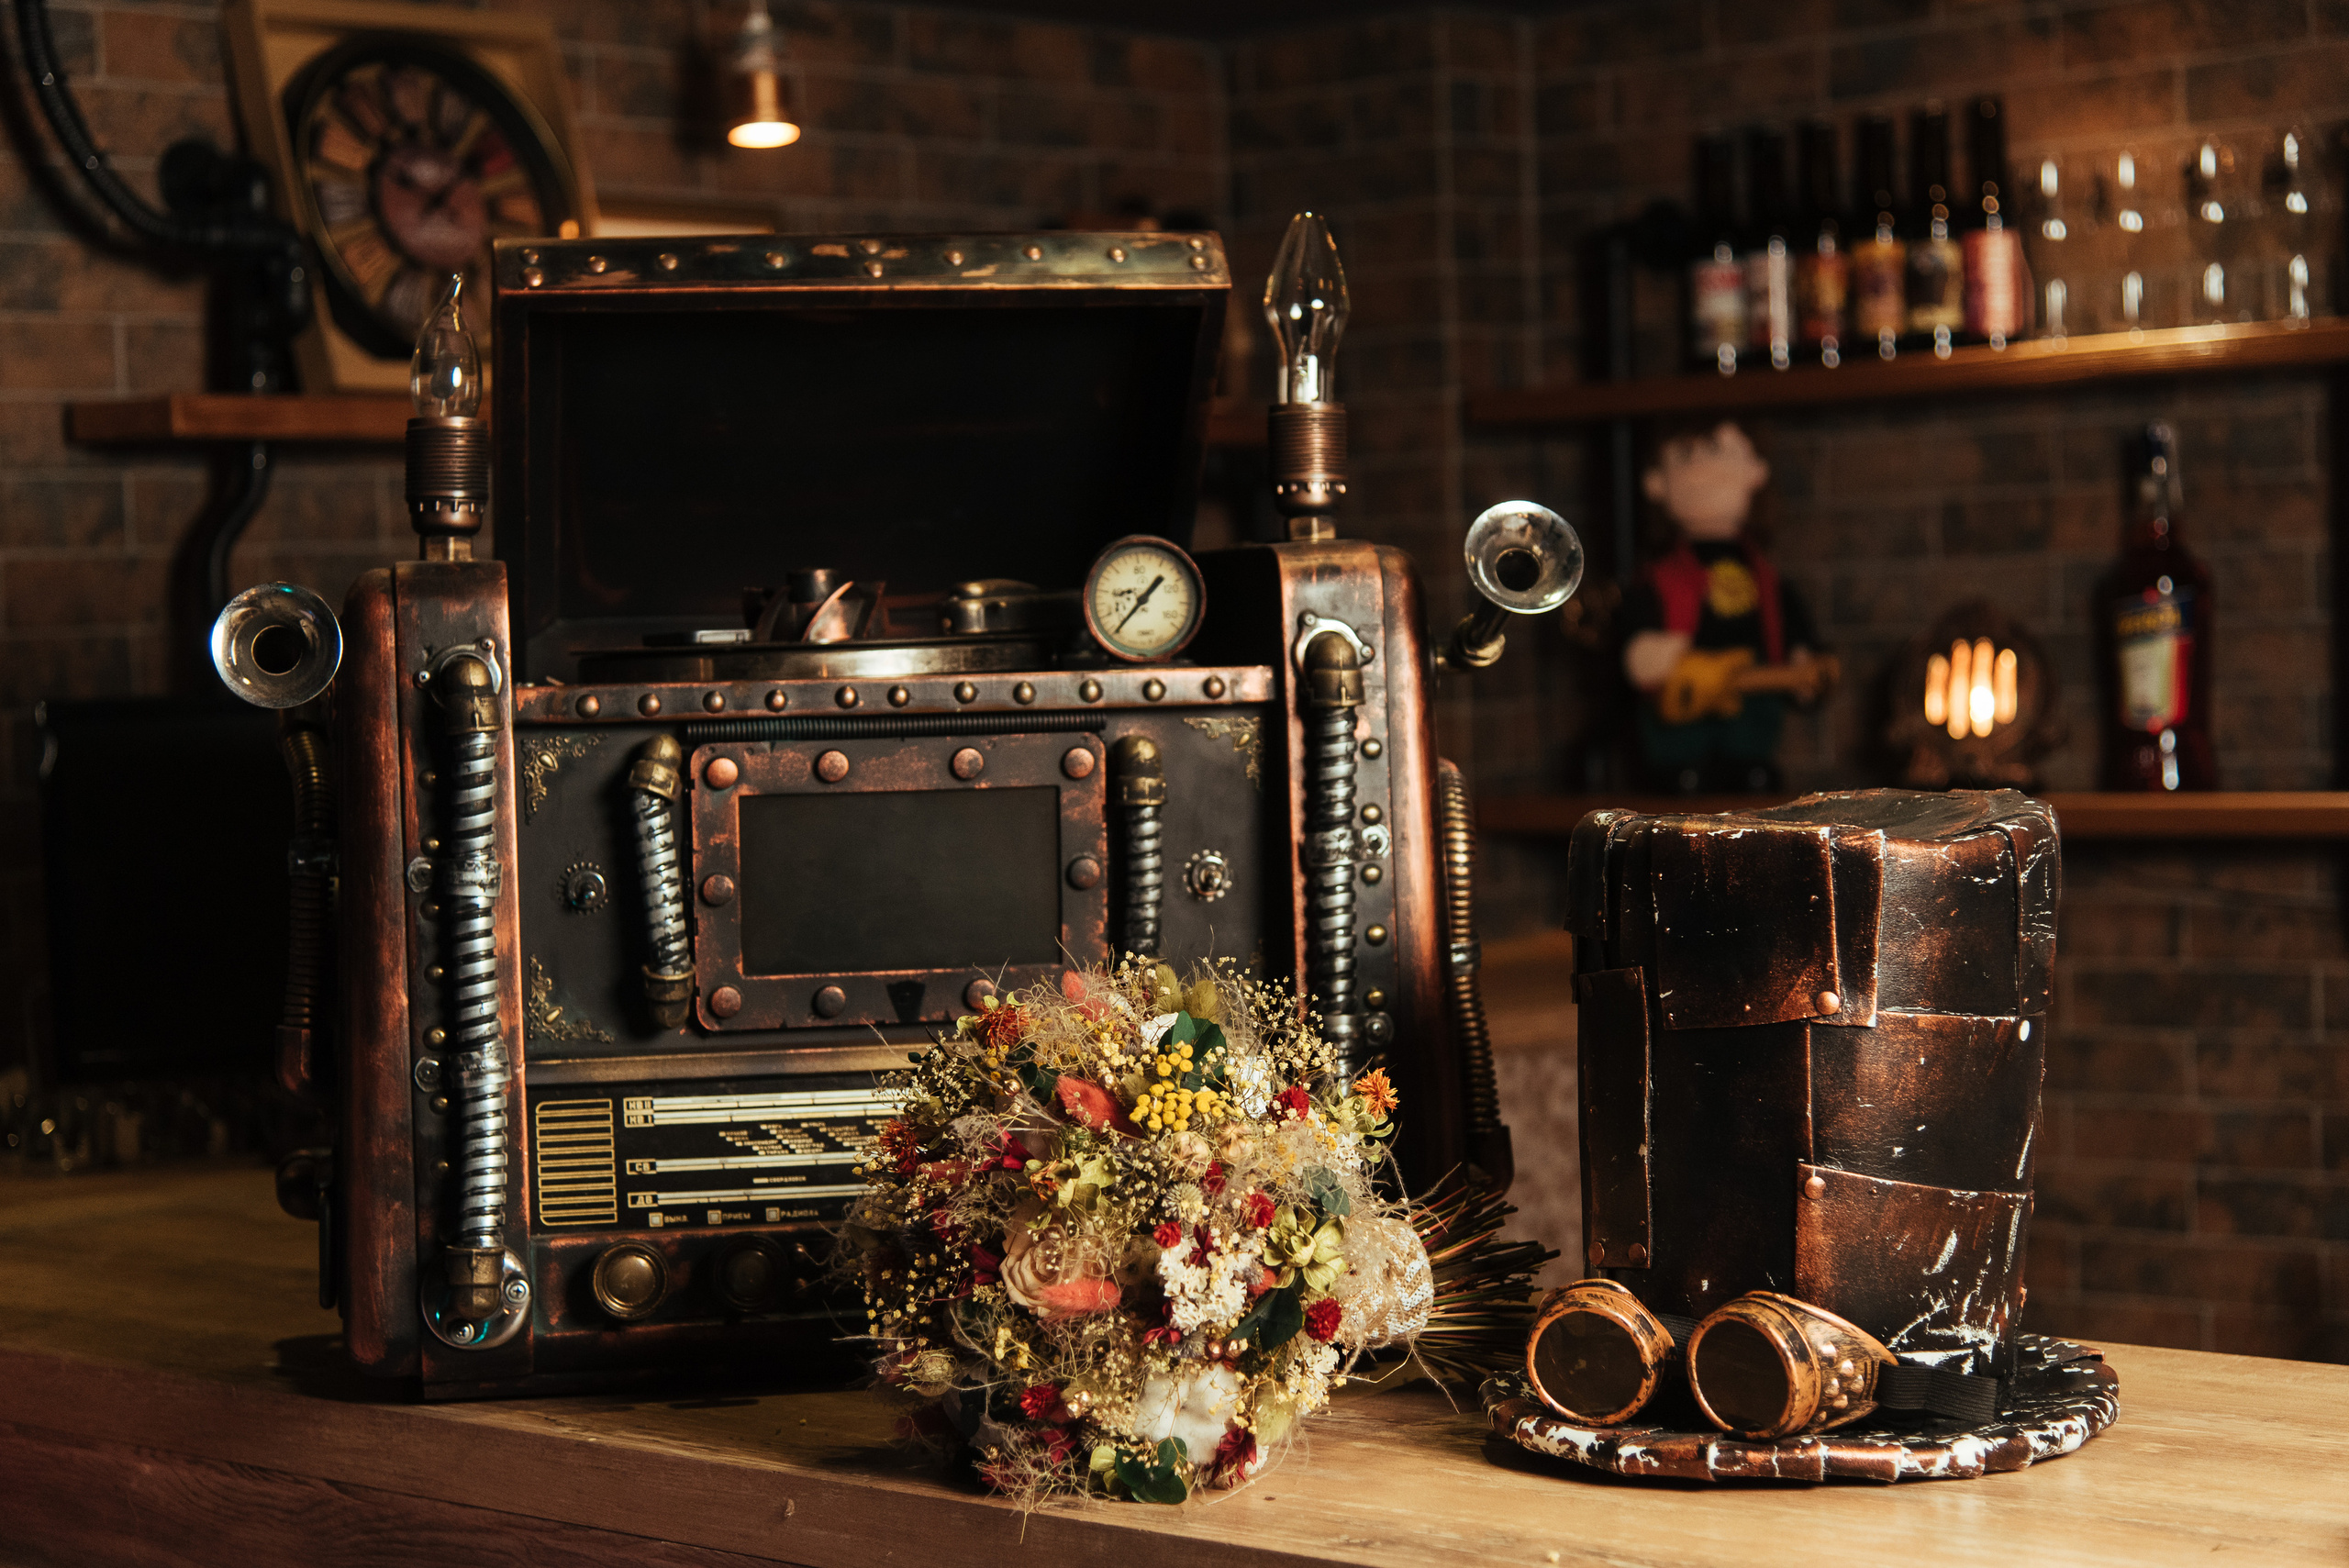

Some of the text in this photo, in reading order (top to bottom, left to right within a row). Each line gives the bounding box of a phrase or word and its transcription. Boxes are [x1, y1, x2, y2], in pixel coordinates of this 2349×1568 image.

[1134, 566, 1145, 574] 80
[1163, 584, 1179, 594] 120
[1163, 610, 1178, 619] 160
[635, 1162, 651, 1172] СВ
[768, 1175, 807, 1184] СВЕРДЛОВСК
[636, 1195, 652, 1206] ДВ
[780, 1209, 819, 1218] РАДИОЛА
